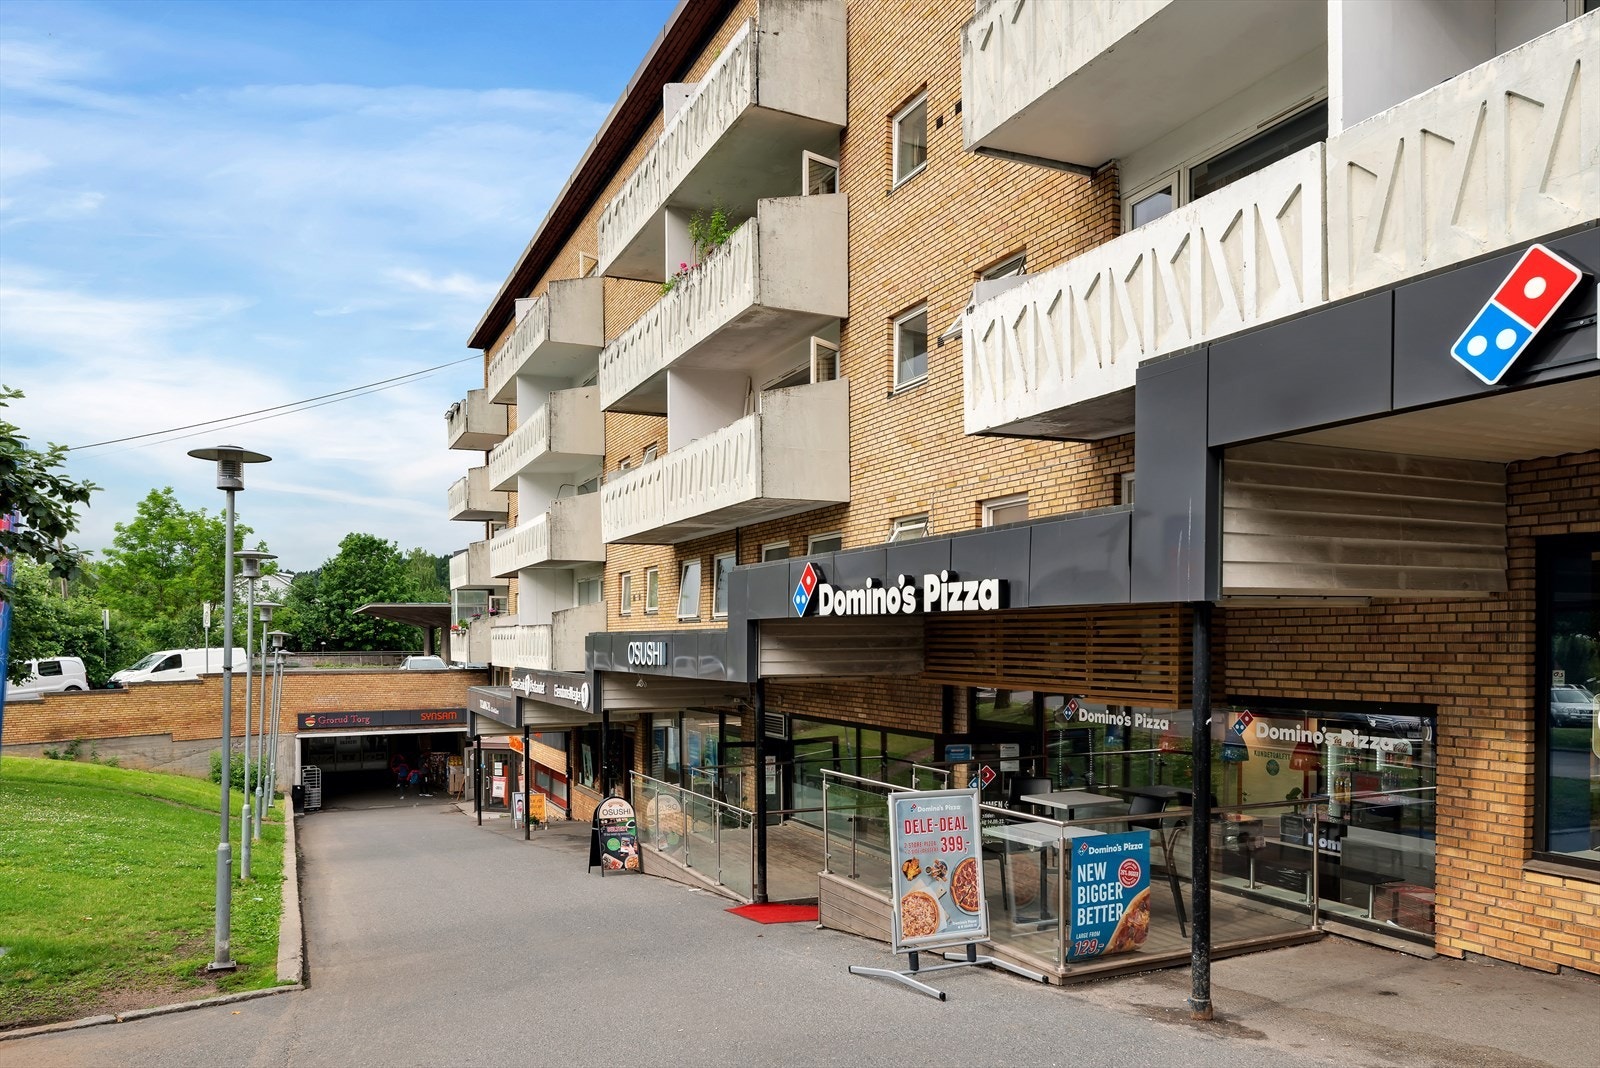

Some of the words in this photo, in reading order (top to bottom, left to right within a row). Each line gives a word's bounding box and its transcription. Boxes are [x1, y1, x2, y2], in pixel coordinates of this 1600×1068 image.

[818, 573, 916, 615] Domino's
[923, 569, 999, 611] Pizza
[627, 641, 665, 665] OSUSHI
[317, 715, 348, 725] Grorud
[351, 714, 370, 725] Torg
[420, 711, 457, 721] SYNSAM
[1078, 708, 1131, 726] Domino's
[1134, 713, 1169, 729] Pizza
[1255, 722, 1333, 745] Domino's
[1341, 729, 1394, 750] Pizza
[602, 808, 630, 816] OSUSHI
[917, 805, 943, 813] Domino's
[904, 816, 968, 834] DELE-DEAL
[1088, 844, 1121, 855] Domino's
[1123, 842, 1142, 851] Pizza
[1077, 861, 1107, 882] NEW
[1077, 881, 1123, 904] BIGGER
[1077, 902, 1123, 926] BETTER
[1076, 932, 1088, 940] LARGE
[1088, 930, 1100, 938] FROM
